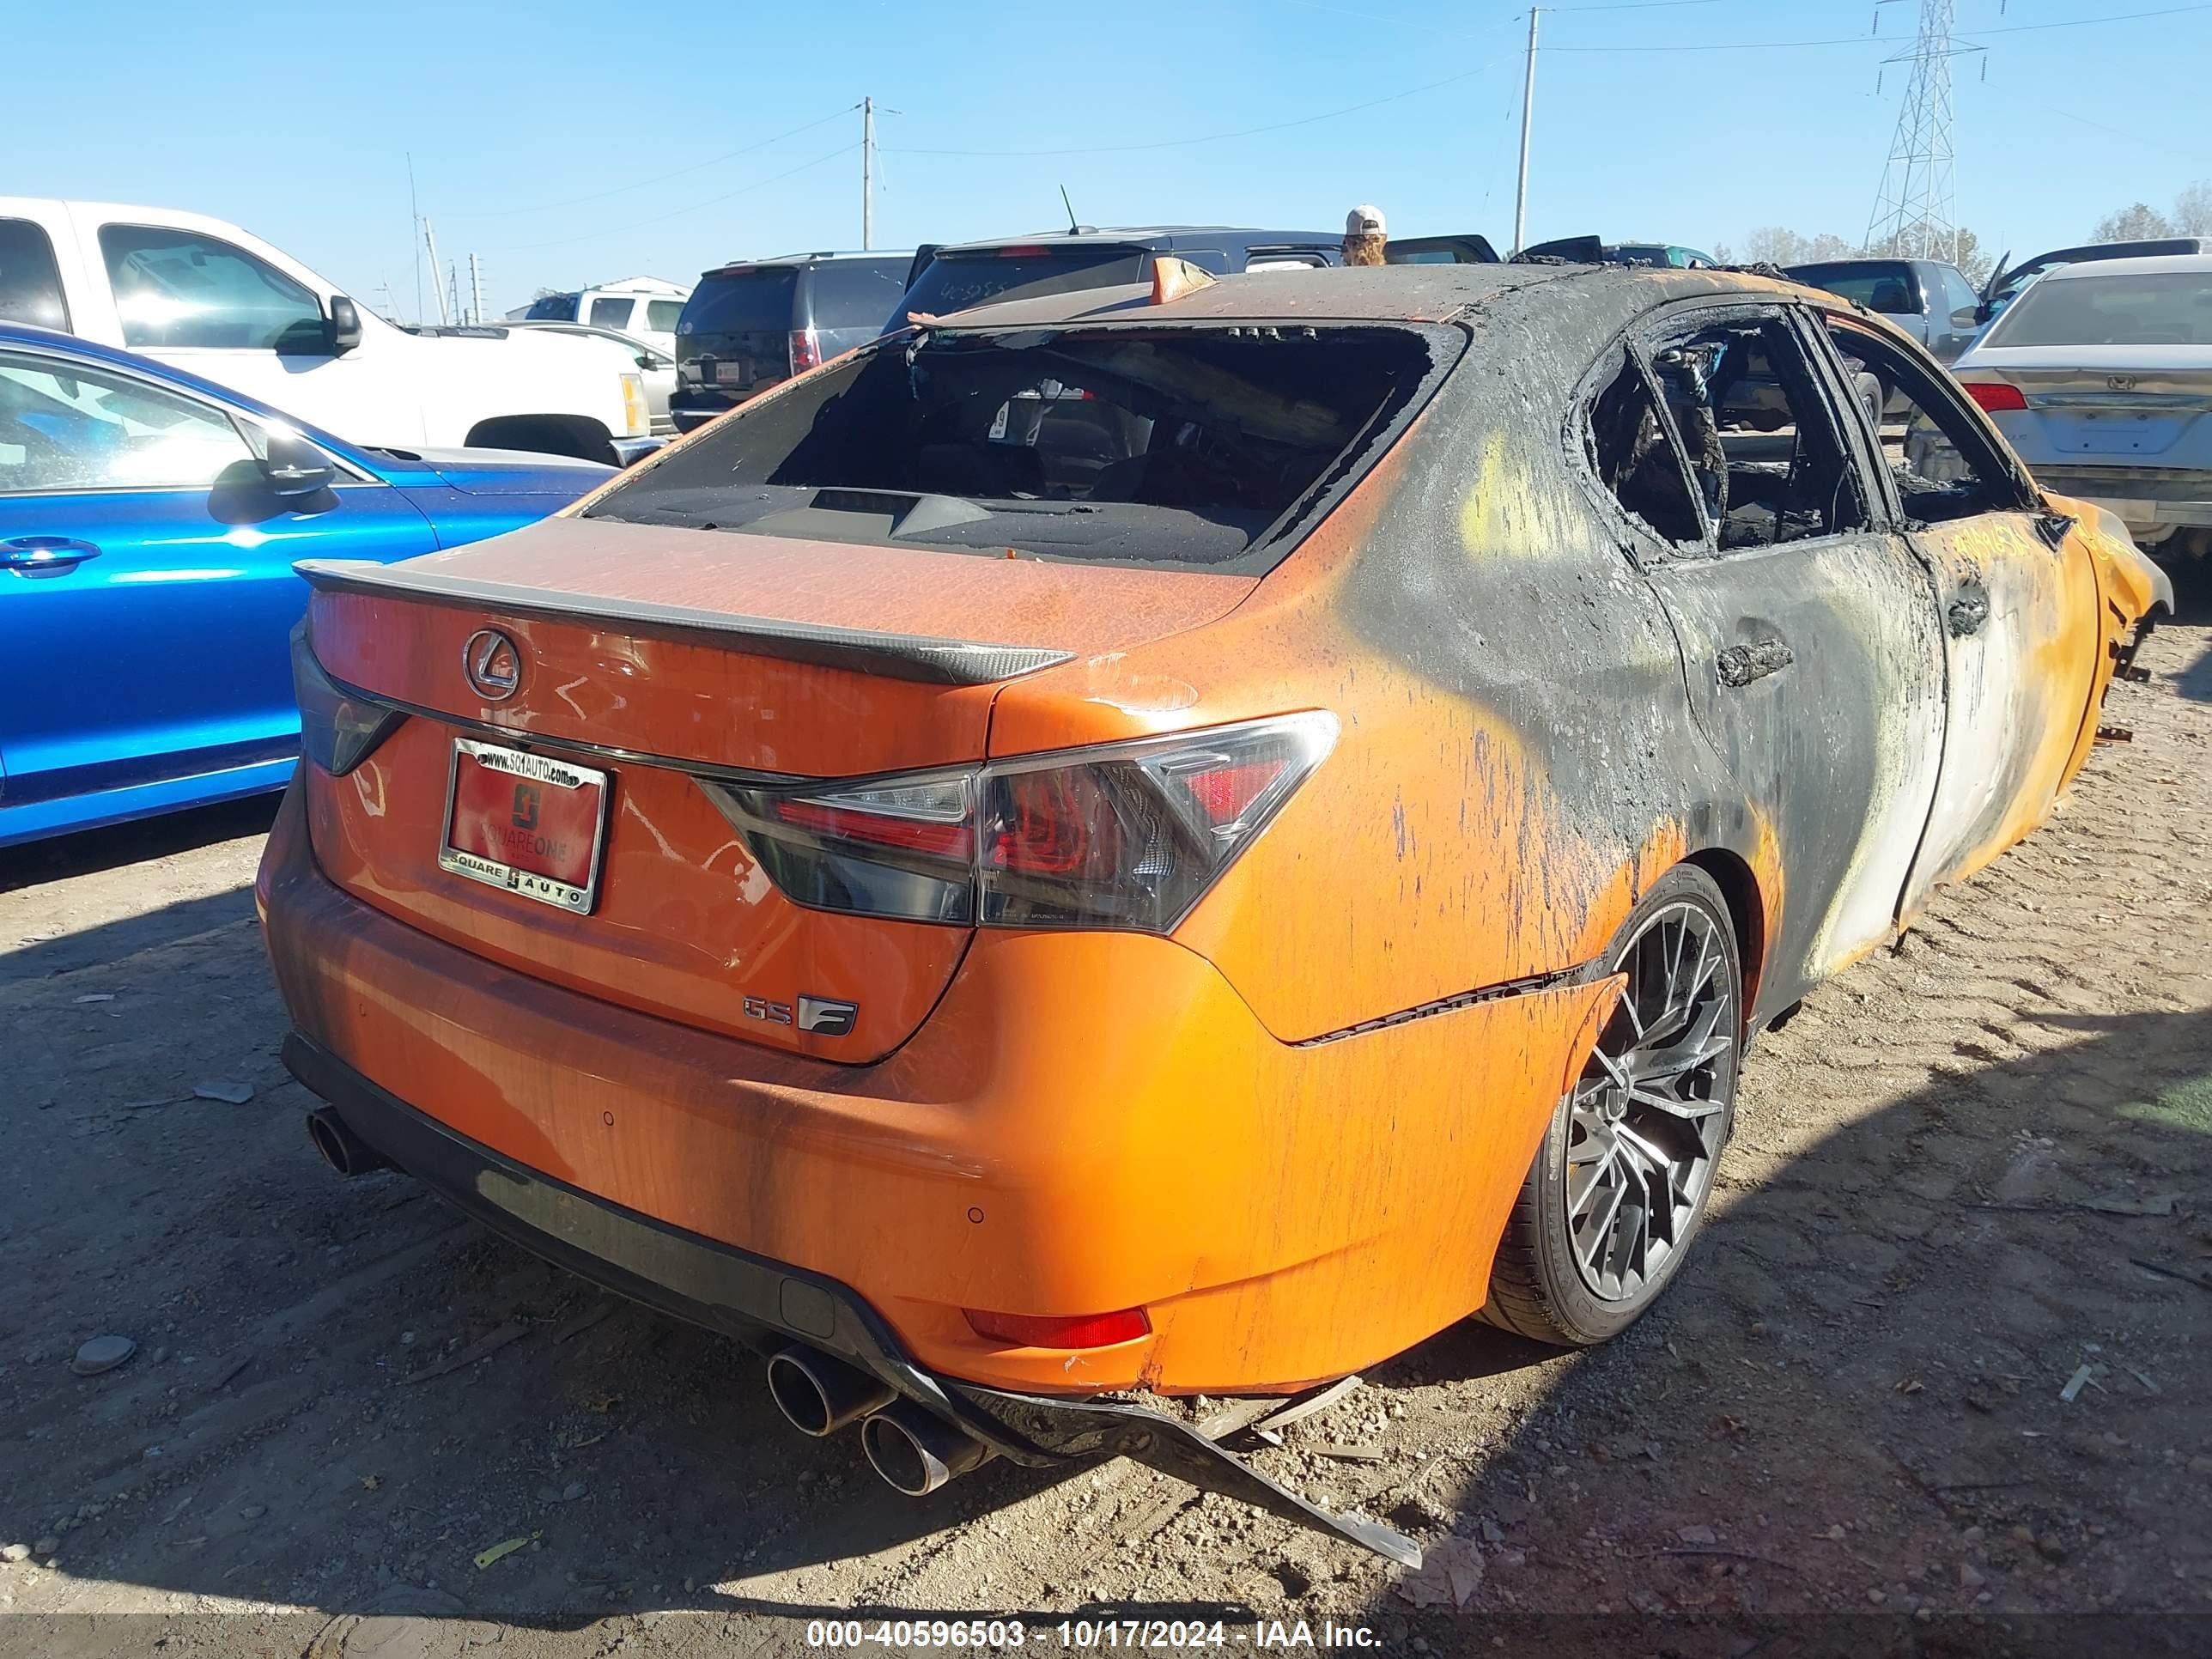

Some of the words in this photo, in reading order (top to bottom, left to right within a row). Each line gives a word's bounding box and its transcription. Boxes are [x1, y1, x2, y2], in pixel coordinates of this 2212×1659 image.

[450, 853, 504, 878] SQUARE
[525, 878, 581, 903] AUTO
[742, 995, 793, 1026] GS
